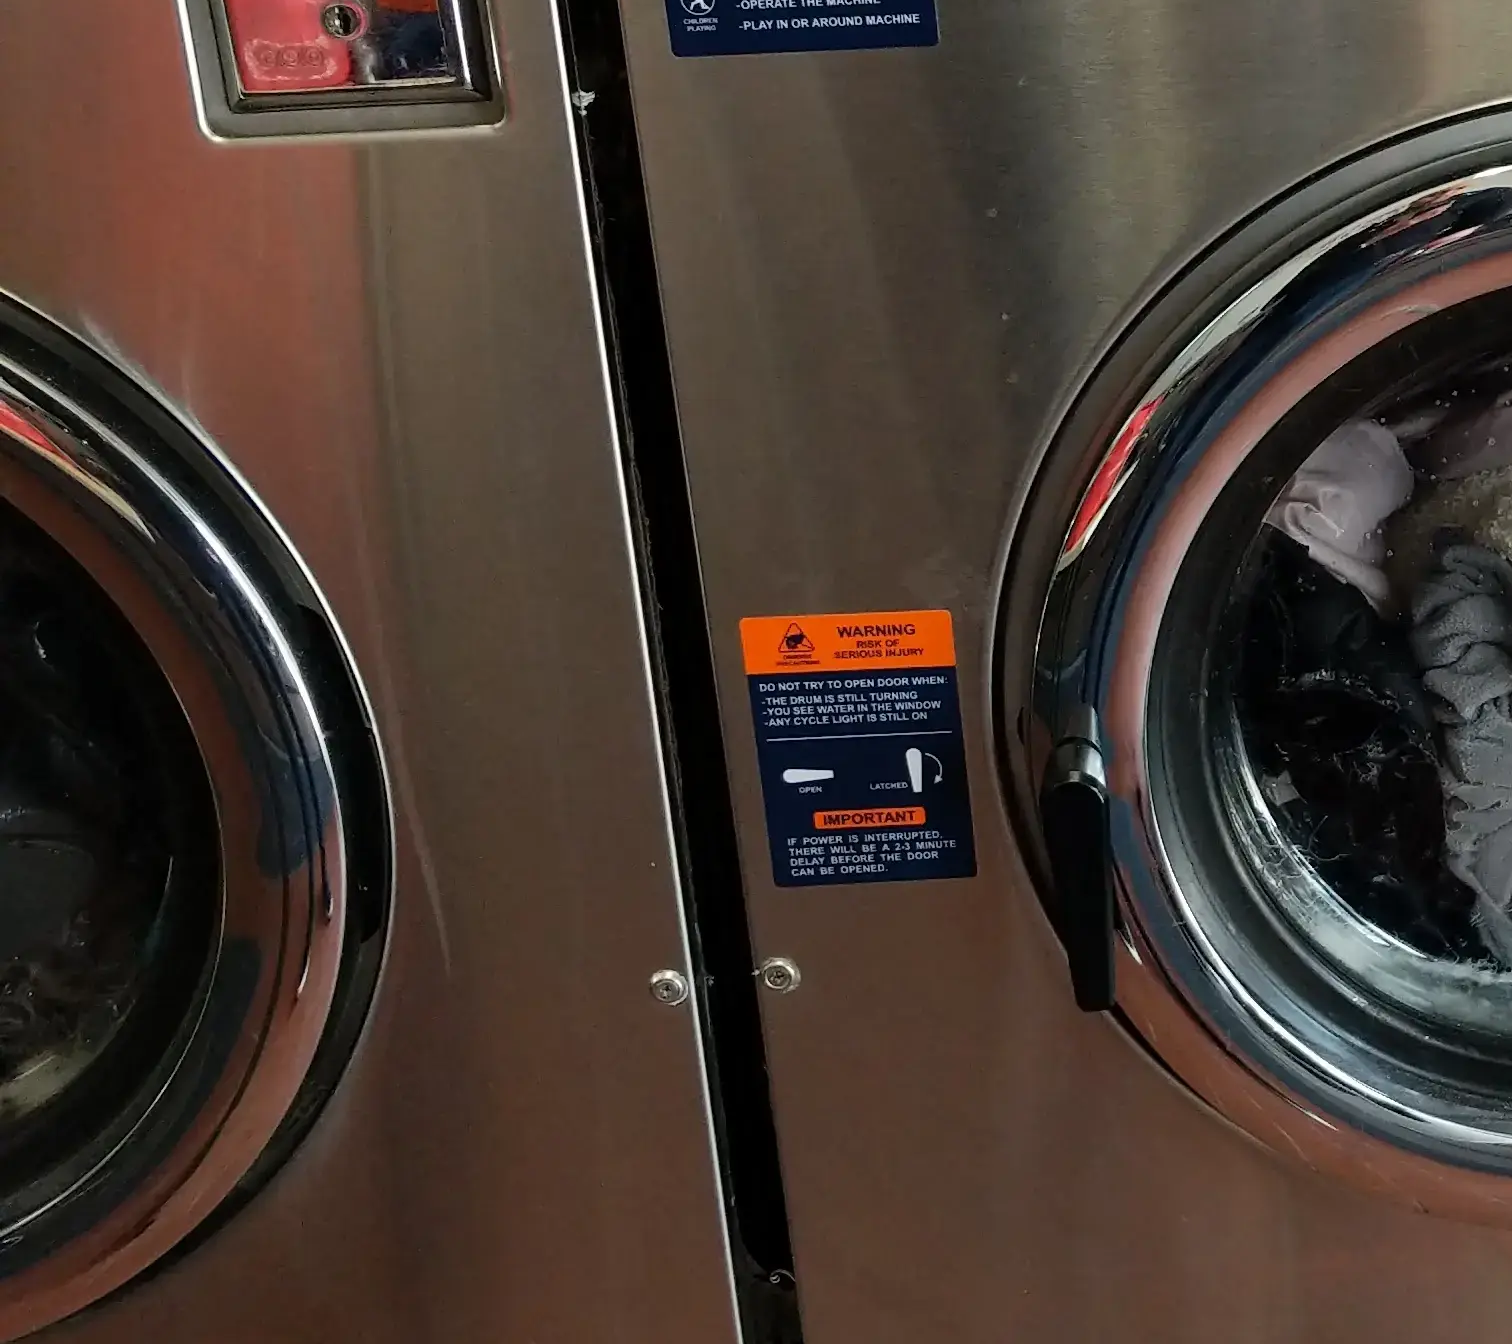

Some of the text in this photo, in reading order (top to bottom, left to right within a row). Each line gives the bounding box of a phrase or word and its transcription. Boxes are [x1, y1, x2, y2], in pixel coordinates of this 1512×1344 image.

[739, 14, 920, 30] -PLAY IN OR AROUND MACHINE
[837, 624, 915, 638] WARNING
[857, 639, 899, 649] RISK OF
[834, 648, 923, 659] SERIOUS INJURY
[759, 676, 948, 692] DO NOT TRY TO OPEN DOOR WHEN:
[824, 810, 916, 825] IMPORTANT
